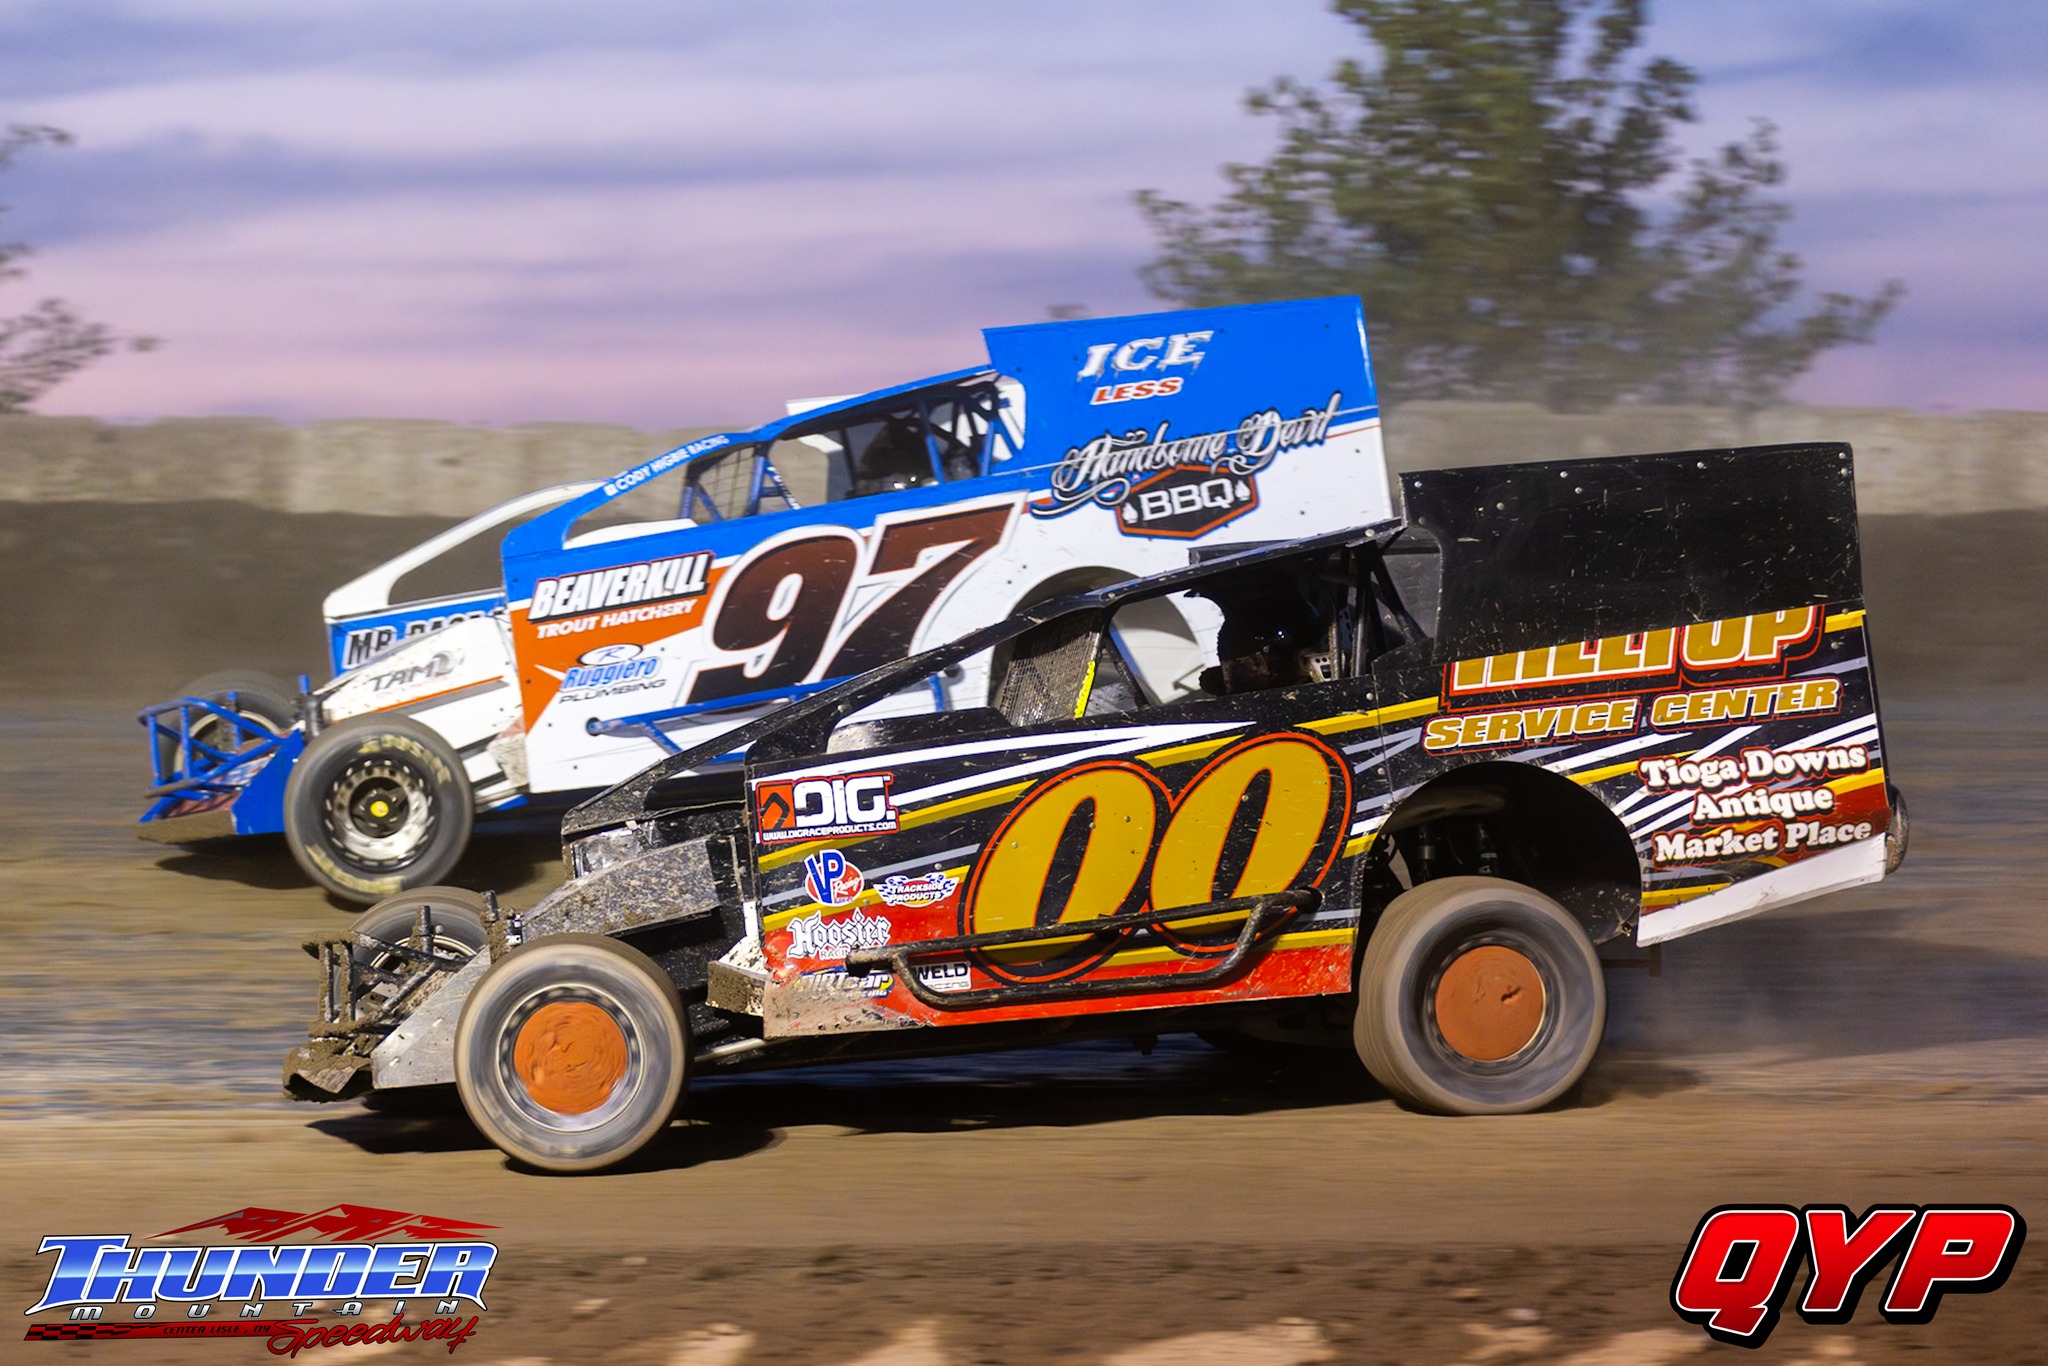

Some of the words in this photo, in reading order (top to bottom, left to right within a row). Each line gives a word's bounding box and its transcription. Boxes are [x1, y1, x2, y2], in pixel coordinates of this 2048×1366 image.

[1077, 330, 1214, 382] ICE
[1091, 376, 1184, 405] LESS
[614, 465, 652, 490] CODY
[687, 435, 730, 455] RACING
[1036, 421, 1228, 508] Handsome
[1218, 391, 1341, 475] Devil
[1138, 478, 1236, 521] BBQ
[527, 552, 712, 622] BEAVERKILL
[684, 500, 1017, 713] 97
[537, 616, 600, 639] TROUT
[601, 599, 698, 629] HATCHERY
[559, 679, 667, 704] PLUMBING
[561, 656, 659, 691] Ruggiero
[1424, 697, 1639, 751] SERVICE
[1650, 678, 1841, 726] CENTER
[1639, 757, 1741, 788] Tioga
[1742, 746, 1868, 778] Downs
[1692, 787, 1834, 821] Antique
[762, 821, 897, 842] WWW.DIGRACEPRODUCTS.COM
[1653, 828, 1780, 863] Market
[1783, 820, 1873, 849] Place
[804, 850, 846, 905] VP
[966, 734, 1351, 981] 00
[888, 890, 942, 903] PRODUCTS
[891, 881, 944, 894] TRACKSIDE
[786, 906, 892, 959] Hoosier
